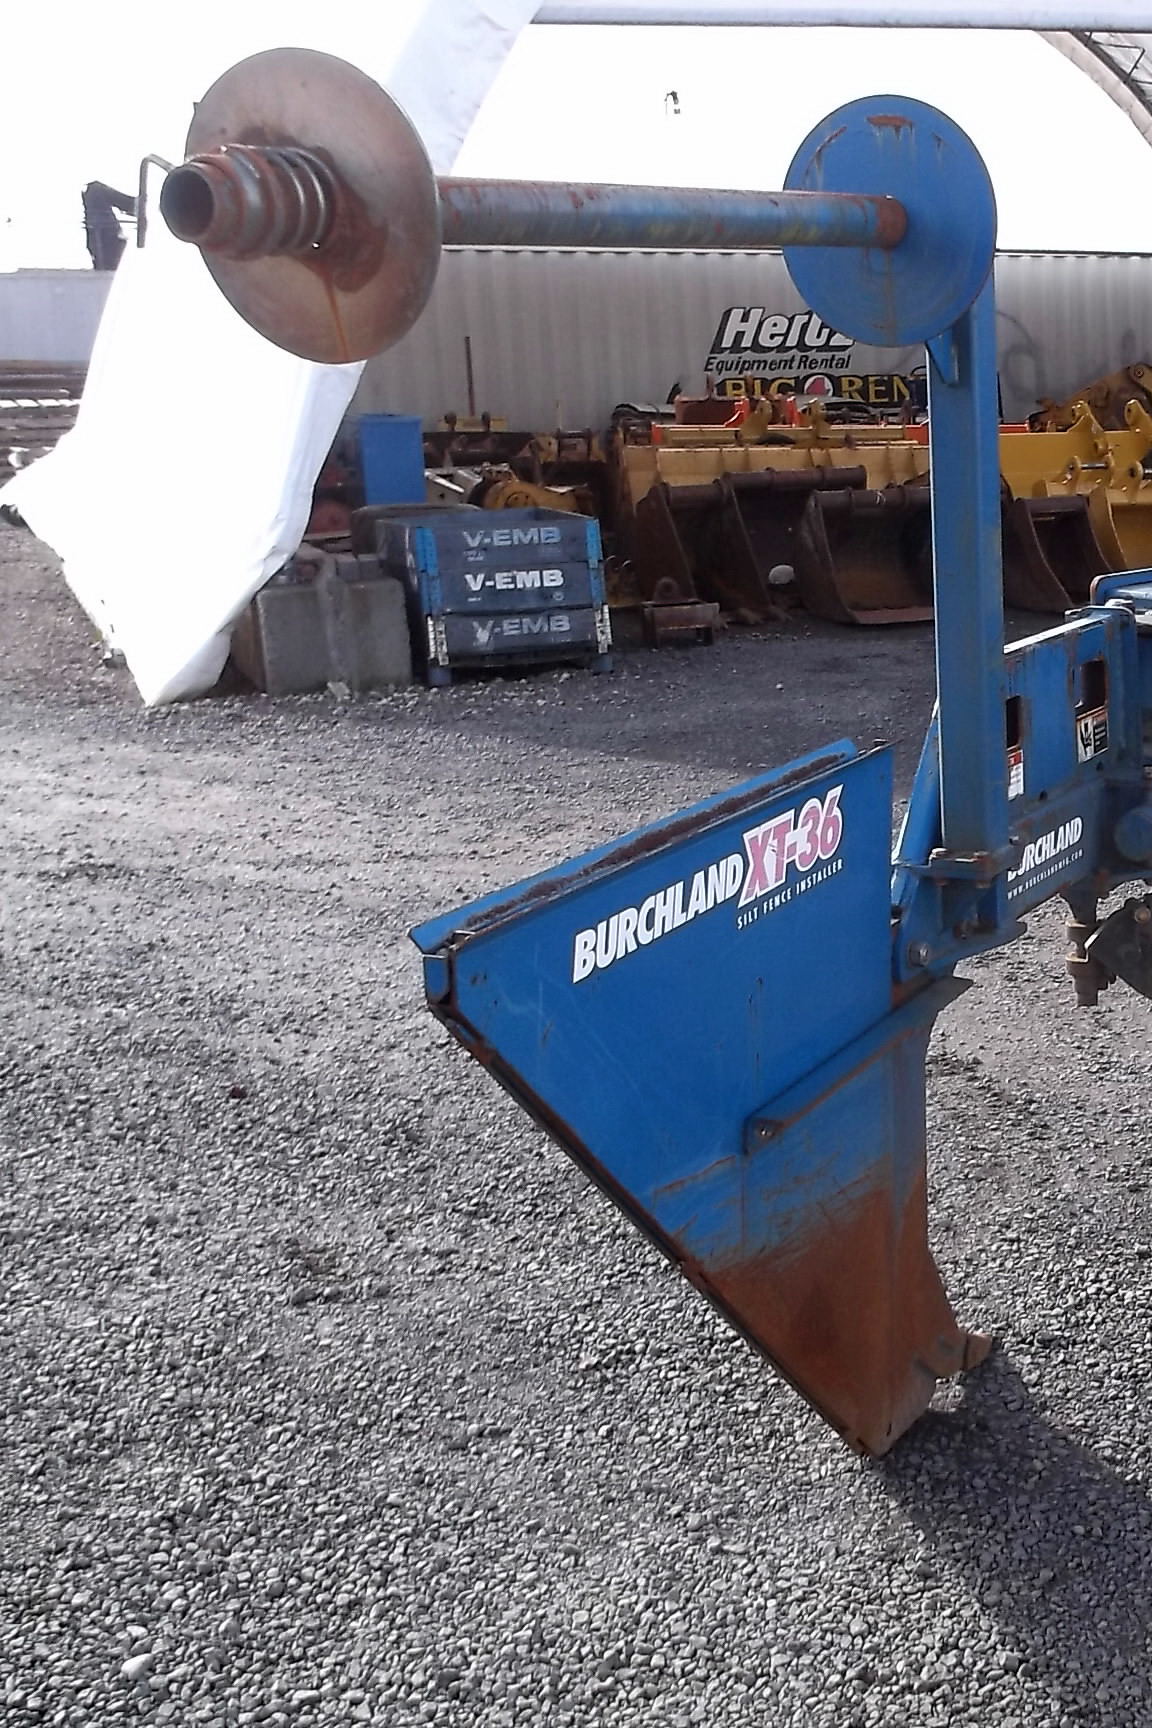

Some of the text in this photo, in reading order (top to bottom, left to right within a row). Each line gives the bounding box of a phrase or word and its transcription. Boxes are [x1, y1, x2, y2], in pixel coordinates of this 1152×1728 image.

[704, 354, 851, 375] Equipment Rental
[462, 526, 561, 547] V-EMB
[464, 569, 564, 591] V-EMB
[573, 783, 844, 984] BURCHLAND XT-36
[737, 858, 843, 930] SILT FENCE INSTALLER
